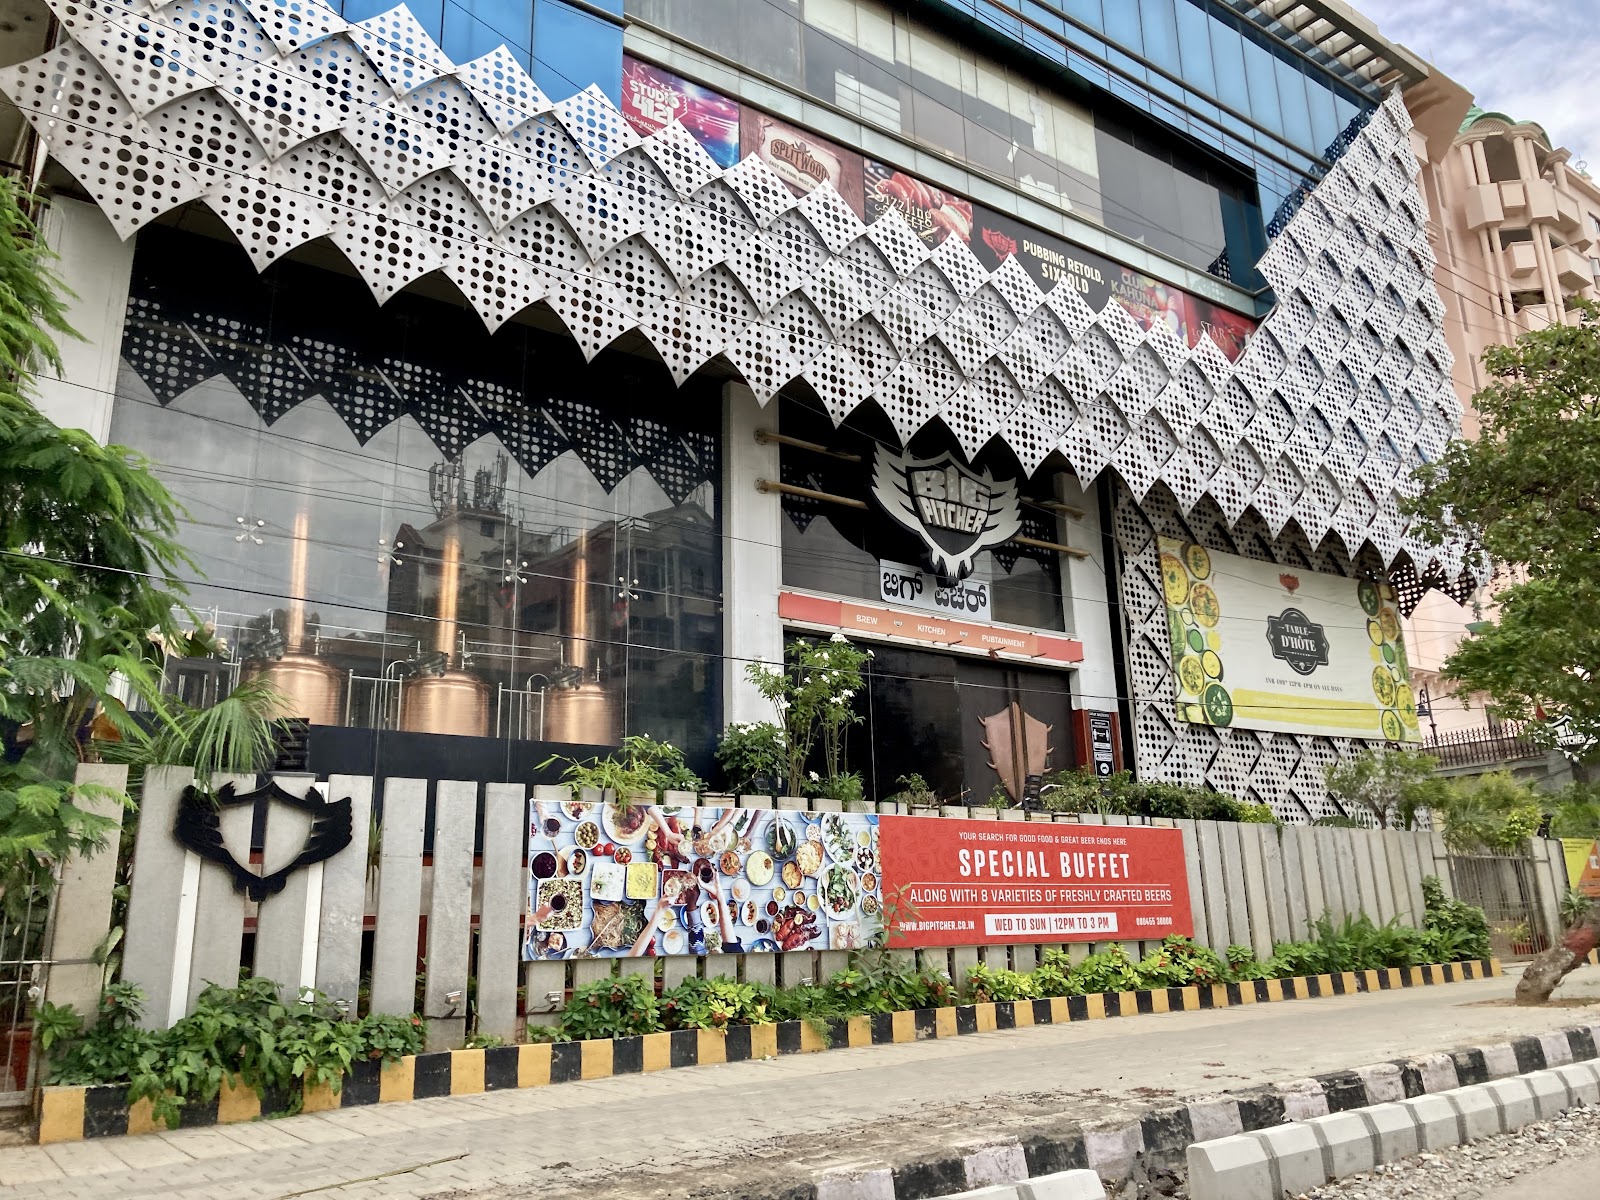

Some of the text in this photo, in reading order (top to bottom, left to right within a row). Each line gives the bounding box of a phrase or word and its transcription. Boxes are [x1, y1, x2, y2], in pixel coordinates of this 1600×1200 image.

[629, 79, 681, 109] STUDIO
[632, 93, 675, 126] 4121
[873, 184, 932, 228] Sizzling
[1023, 239, 1065, 267] PUBBING
[1067, 257, 1105, 286] RETOLD,
[1110, 279, 1159, 309] KAHUNA
[911, 466, 991, 511] BIG
[915, 496, 988, 534] PITCHER
[883, 571, 923, 601] ಬಿಗ್
[856, 614, 1026, 648] BREW KITCHEN PUBTAINMENT
[1281, 635, 1317, 652] D'HÔTE
[1284, 624, 1309, 636] TABLE
[959, 832, 1127, 846] YOUR SEARCH FOR GOOD FOOD & GREAT BEER ENDS HERE
[958, 848, 1130, 879] SPECIAL BUFFET
[910, 888, 1172, 903] ALONG WITH 8 VARIETIES OF FRESHLY CRAFTED BEERS
[899, 920, 975, 931] WWW.BIGPITCHER.CO.IN
[994, 916, 1110, 931] WED TO SUN 12PM TO 3 PM
